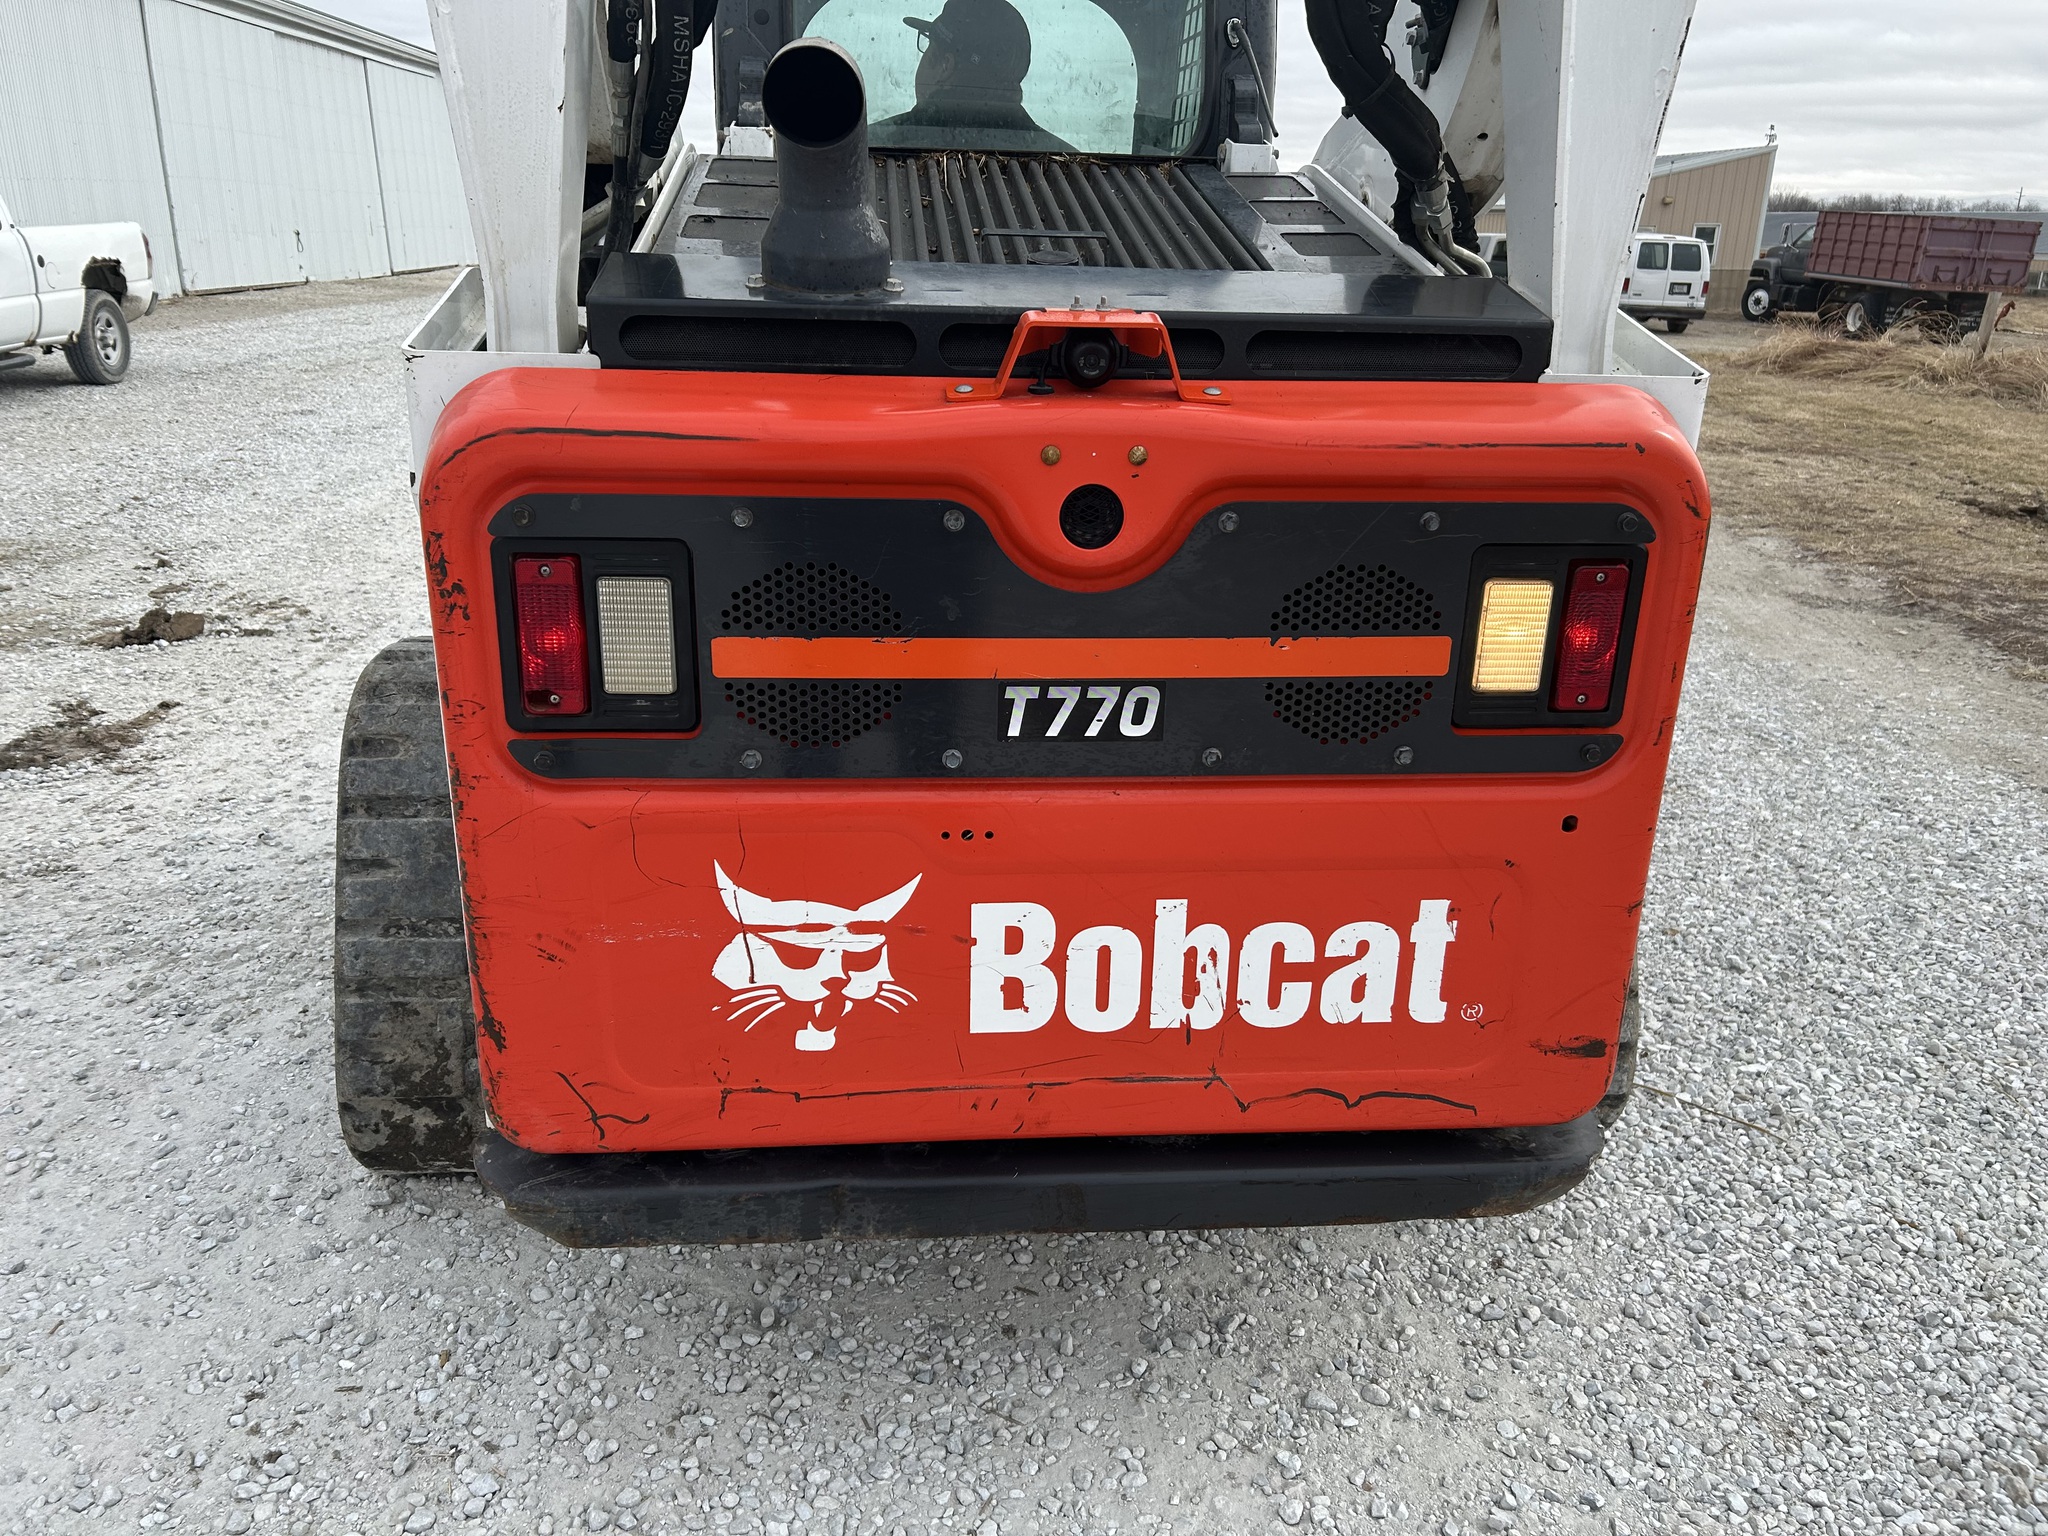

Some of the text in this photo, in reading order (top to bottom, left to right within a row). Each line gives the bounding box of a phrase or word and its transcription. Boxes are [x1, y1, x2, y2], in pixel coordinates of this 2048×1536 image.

[671, 15, 690, 83] MSHA
[1004, 685, 1161, 737] T770
[970, 898, 1457, 1034] Bobcat
